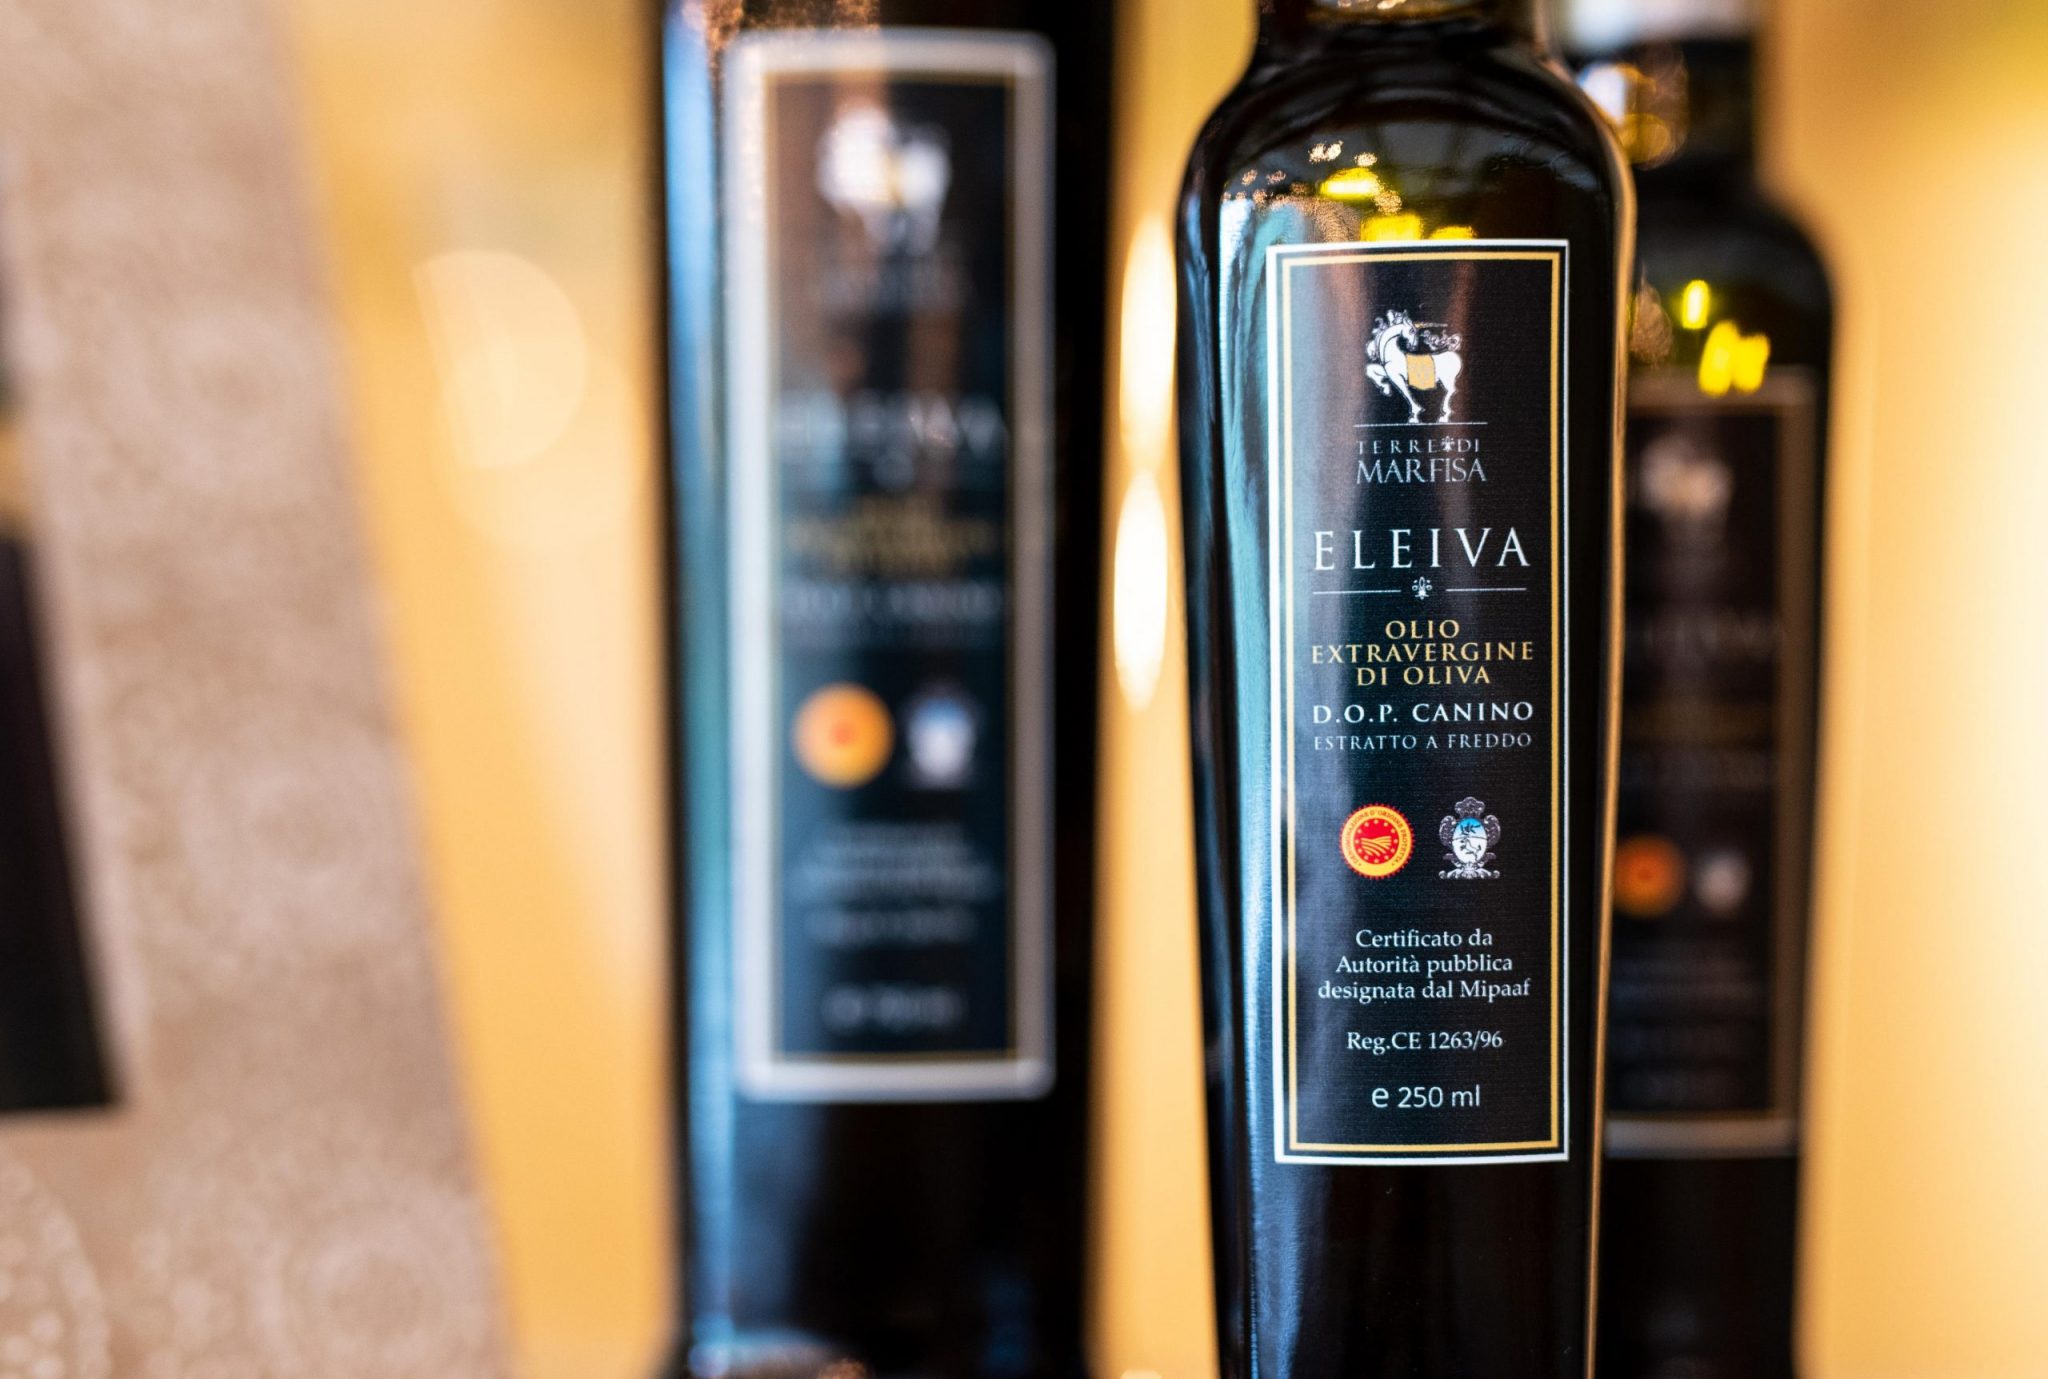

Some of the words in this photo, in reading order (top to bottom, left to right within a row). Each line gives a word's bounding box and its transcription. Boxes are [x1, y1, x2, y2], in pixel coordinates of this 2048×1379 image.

[1356, 438, 1445, 454] TERRE
[1458, 438, 1480, 453] DI
[1355, 457, 1488, 484] MARFISA
[1313, 527, 1531, 570] ELEIVA
[1385, 619, 1460, 640] OLIO
[1311, 642, 1534, 664] EXTRAVERGINE
[1356, 668, 1388, 686] DI
[1403, 665, 1491, 686] OLIVA
[1312, 704, 1398, 724] D.O.P.
[1412, 701, 1534, 723] CANINO
[1314, 735, 1417, 751] ESTRATTO
[1426, 735, 1438, 749] A
[1448, 732, 1532, 749] FREDDO
[1355, 929, 1463, 947] Certificato
[1468, 928, 1493, 946] da
[1336, 954, 1420, 973] Autorità
[1427, 954, 1513, 977] pubblica
[1317, 979, 1416, 1004] designata
[1422, 980, 1454, 998] dal
[1460, 978, 1531, 1003] Mipaaf
[1347, 1031, 1421, 1055] Reg.CE
[1428, 1030, 1503, 1050] 1263/96
[1397, 1086, 1444, 1108] 250
[1451, 1084, 1481, 1107] ml
